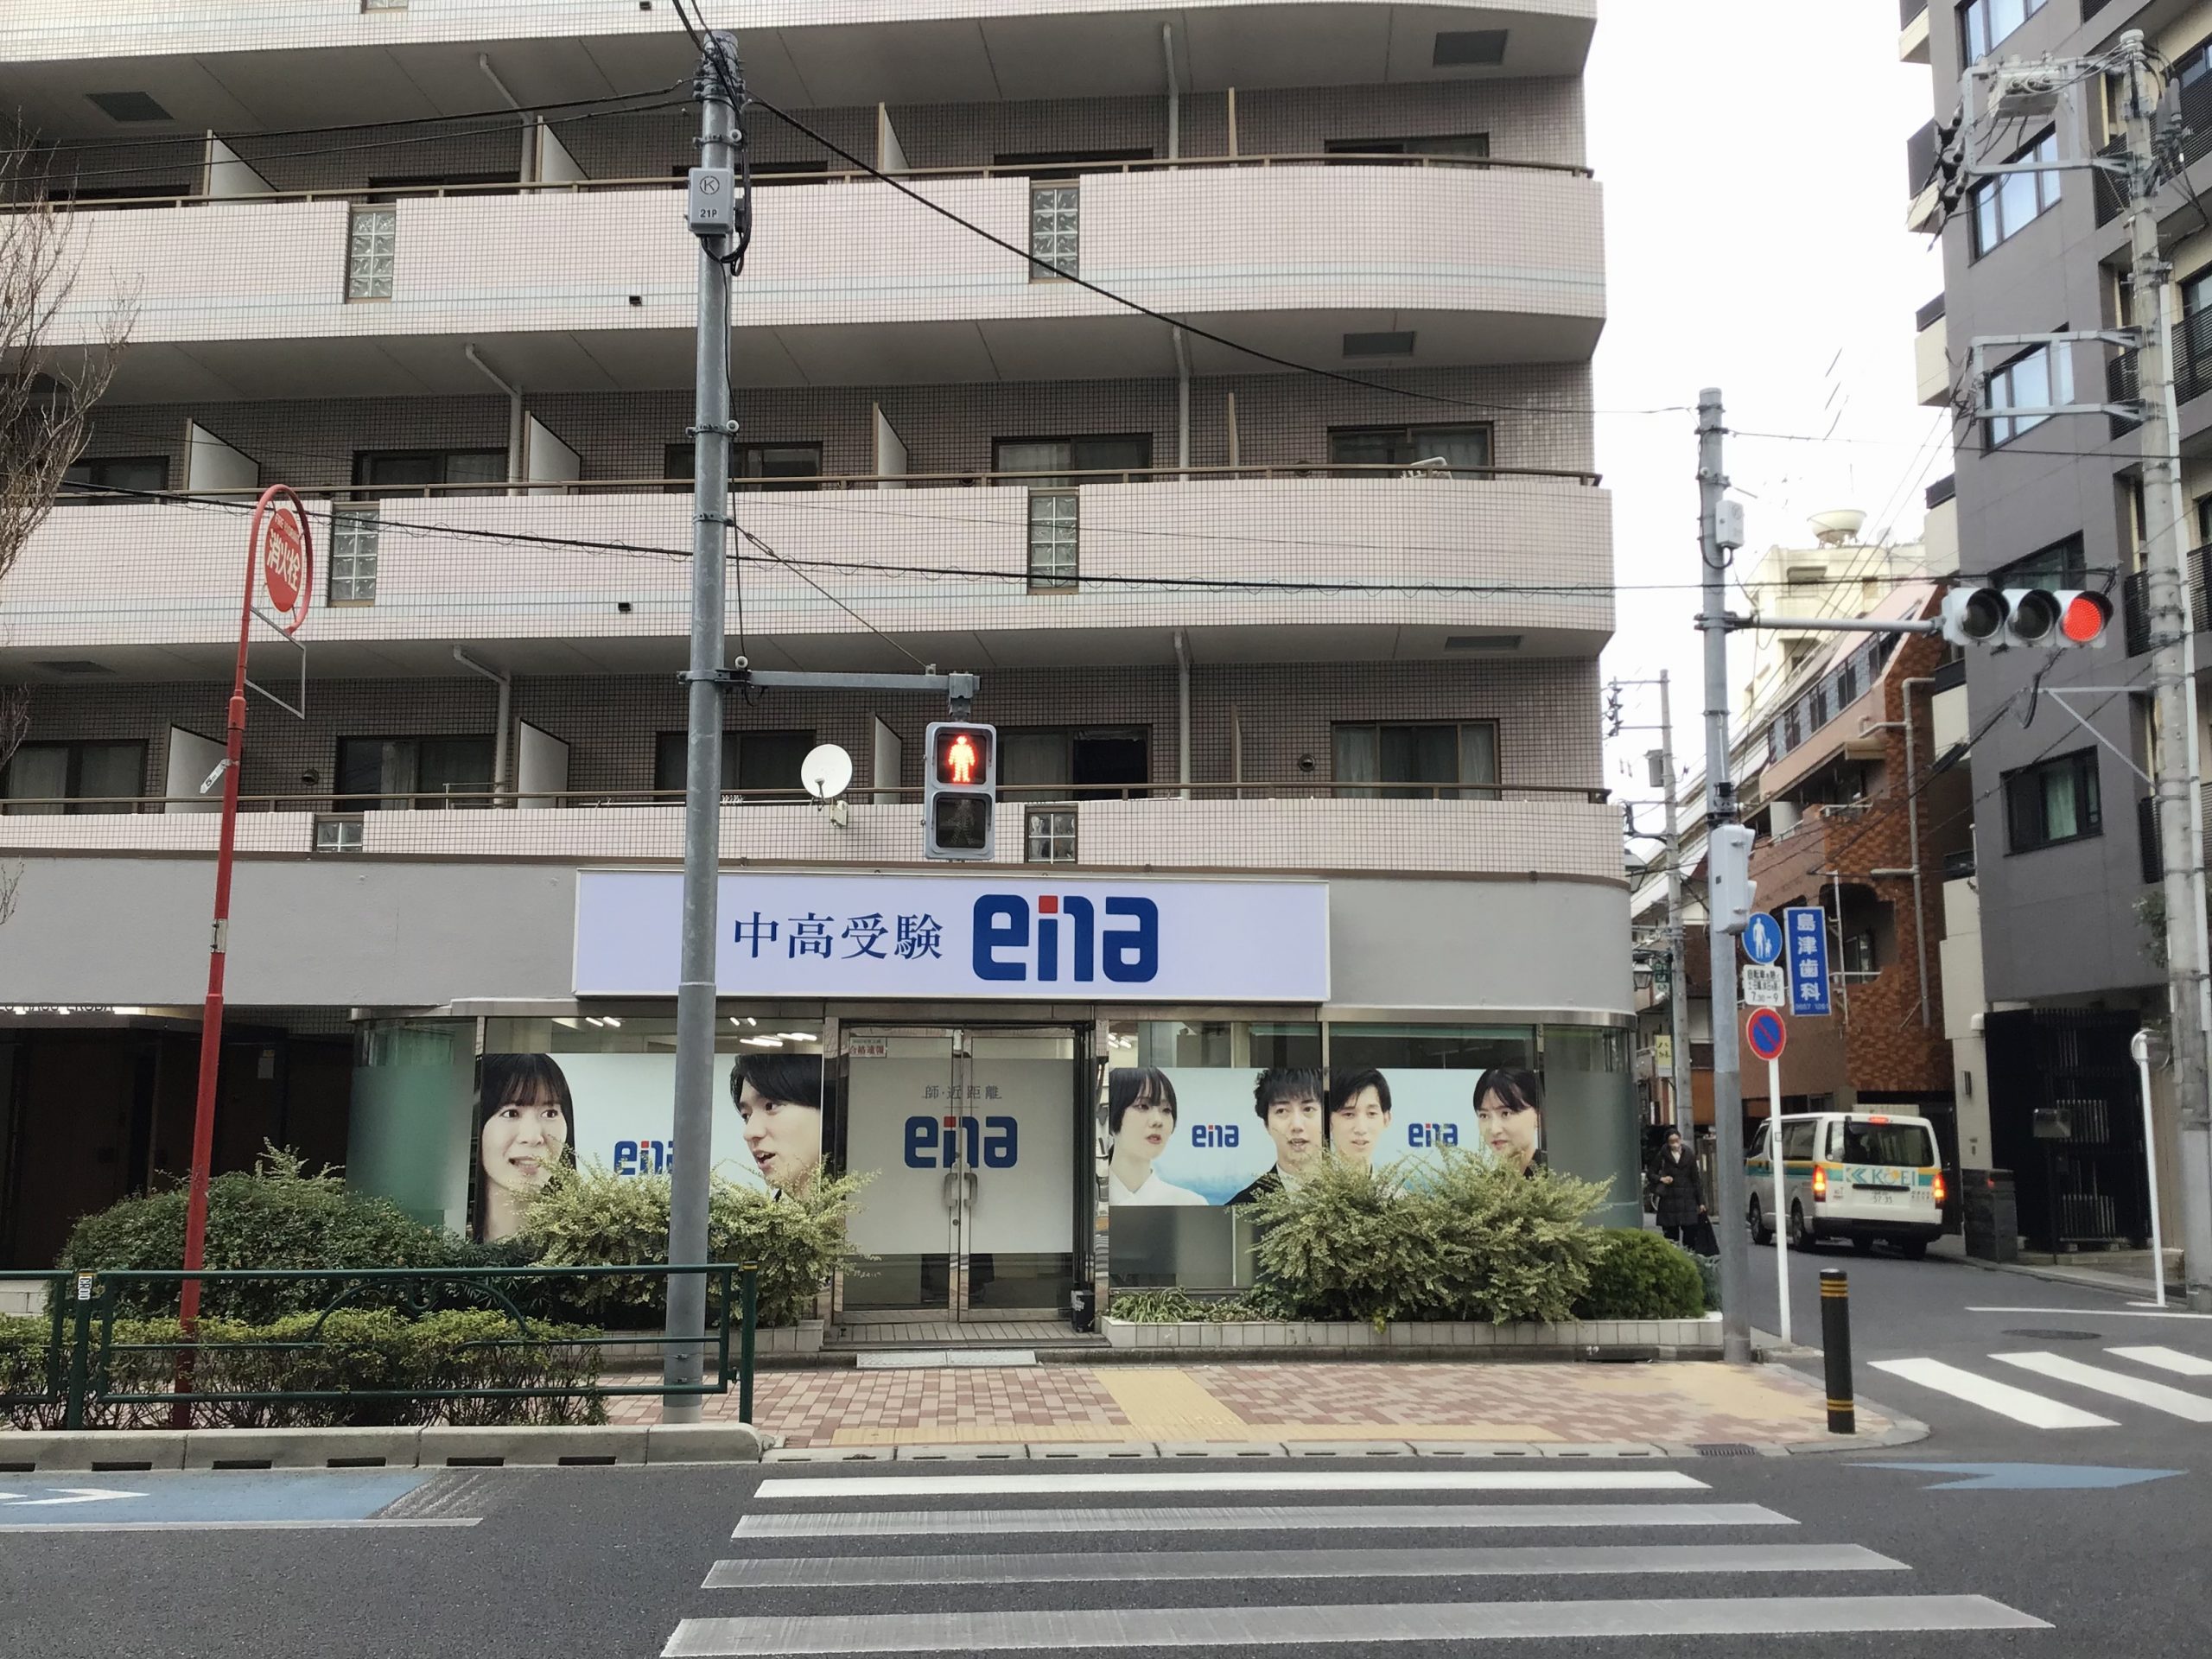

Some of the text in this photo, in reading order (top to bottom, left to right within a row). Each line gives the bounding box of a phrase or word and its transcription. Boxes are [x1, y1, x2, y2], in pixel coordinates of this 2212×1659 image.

[700, 208, 717, 218] 21P
[267, 528, 300, 592] 消火栓
[734, 911, 944, 960] 中高受験
[1797, 912, 1821, 1001] 島津歯科
